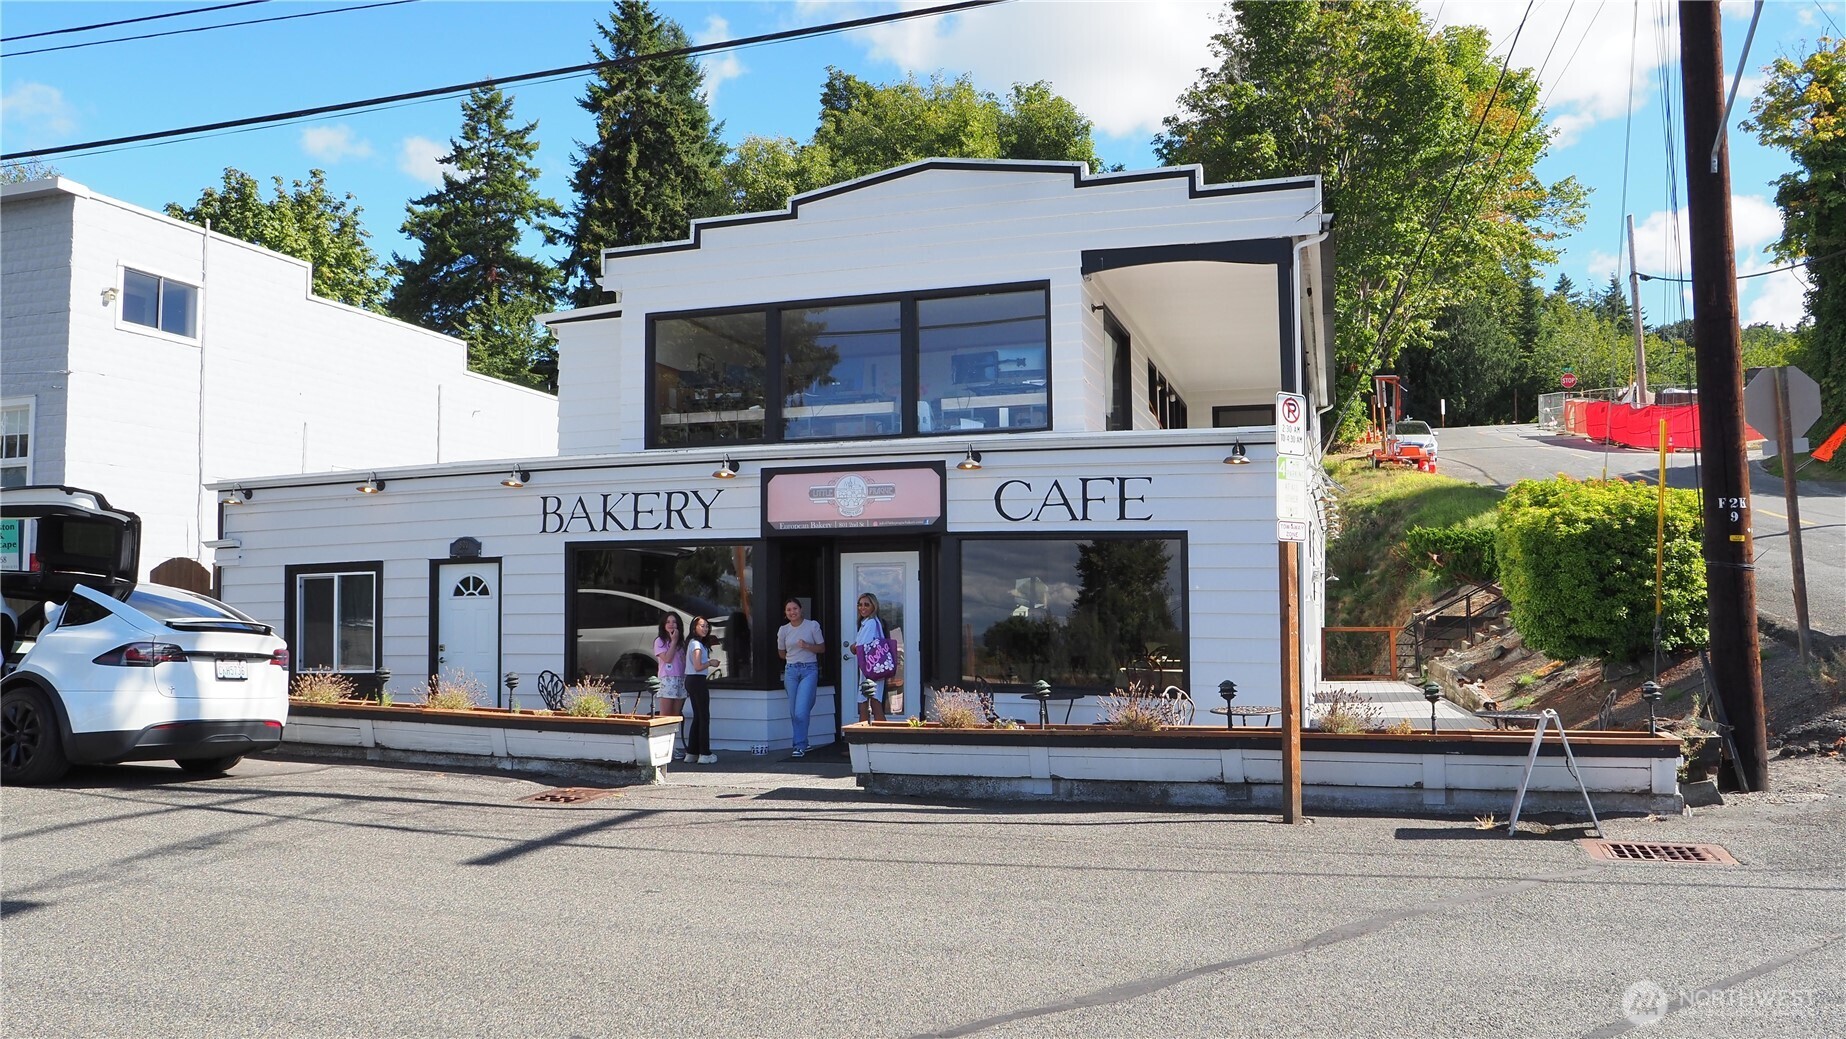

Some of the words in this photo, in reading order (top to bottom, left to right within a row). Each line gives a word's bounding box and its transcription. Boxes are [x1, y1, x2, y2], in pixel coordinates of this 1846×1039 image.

[812, 488, 834, 497] LITTLE
[868, 486, 894, 496] PRAGUE
[993, 477, 1153, 522] CAFE
[539, 489, 725, 534] BAKERY
[1730, 511, 1739, 522] 9
[779, 522, 809, 530] European
[810, 521, 833, 529] Bakery
